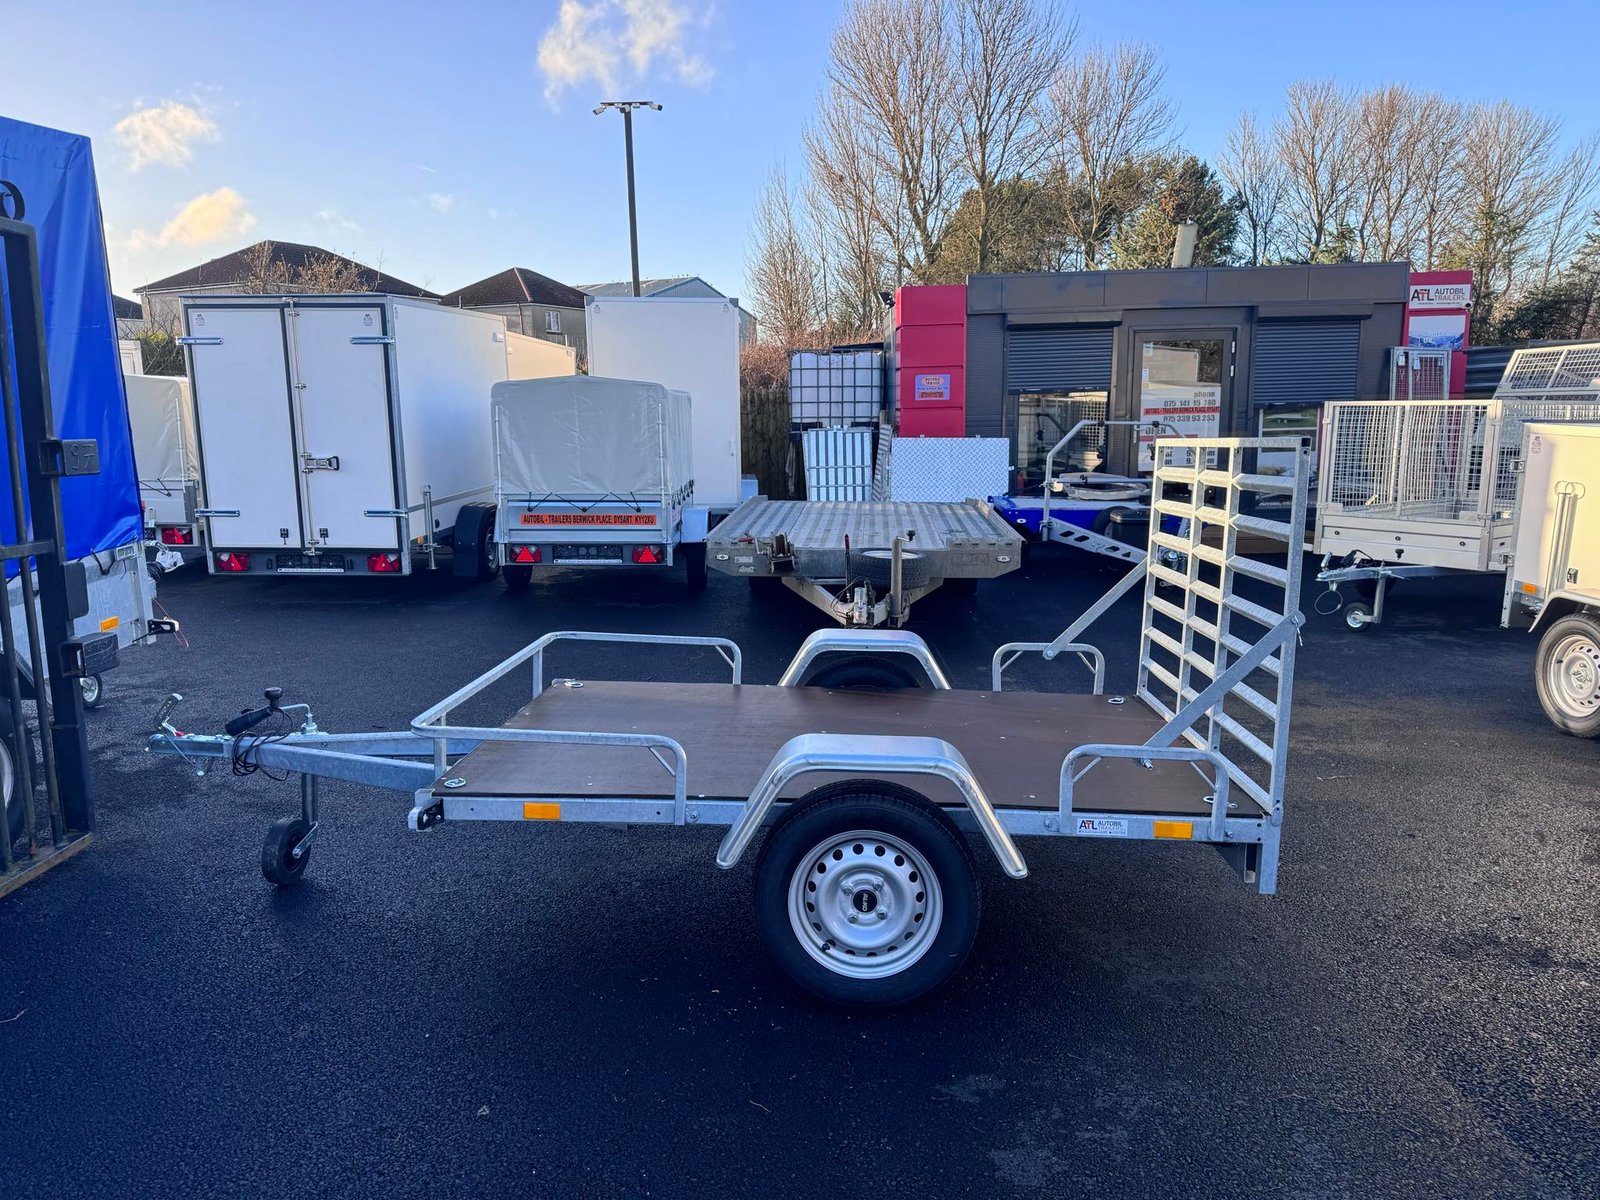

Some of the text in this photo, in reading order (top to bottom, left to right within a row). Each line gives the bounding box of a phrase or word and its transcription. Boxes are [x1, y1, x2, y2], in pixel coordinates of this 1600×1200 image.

[1411, 287, 1465, 301] ATL AUTOBIL
[524, 514, 545, 524] AUTOBIL
[548, 514, 572, 524] TRAILERS
[572, 514, 595, 524] BERWICK
[1079, 820, 1098, 830] ATL
